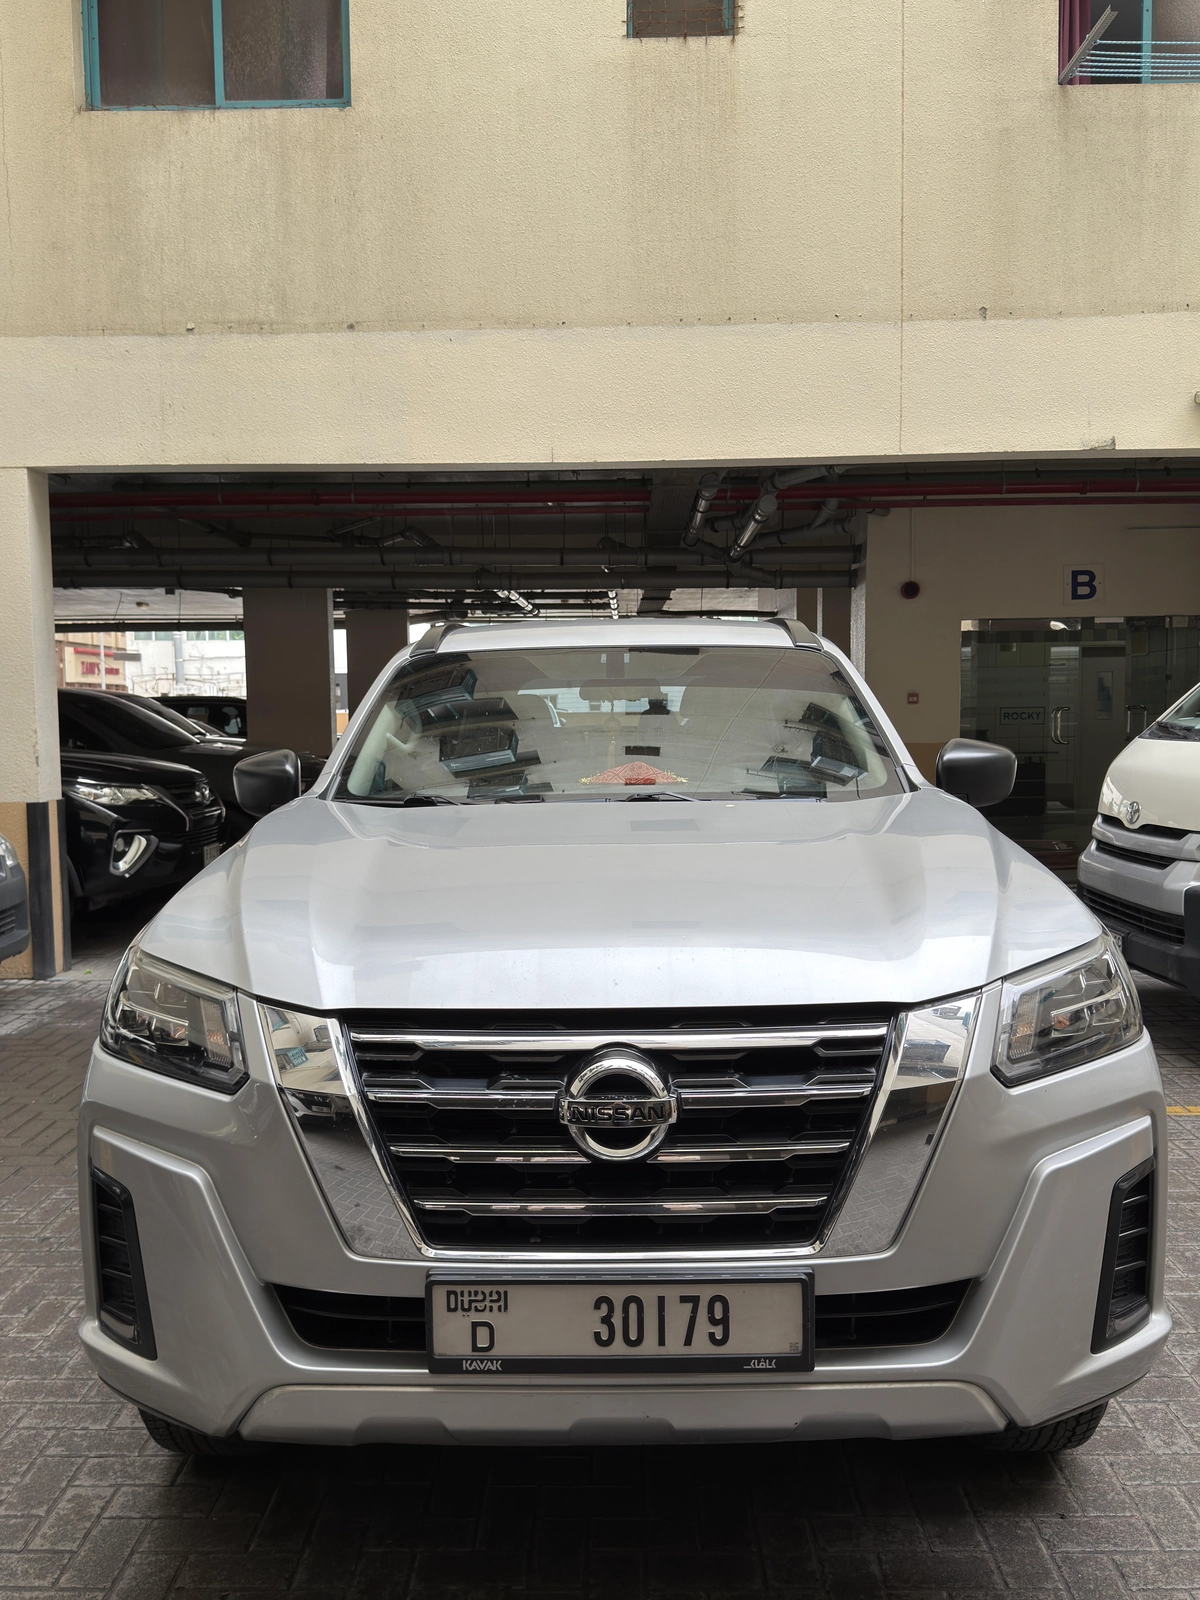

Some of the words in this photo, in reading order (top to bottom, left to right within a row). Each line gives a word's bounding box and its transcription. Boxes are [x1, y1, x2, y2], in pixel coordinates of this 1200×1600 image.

[1071, 570, 1097, 600] B
[1003, 711, 1041, 721] ROCKY
[570, 1106, 665, 1122] NISSAN
[593, 1294, 730, 1348] 30179
[471, 1320, 495, 1353] D
[462, 1360, 502, 1371] KAVAK
